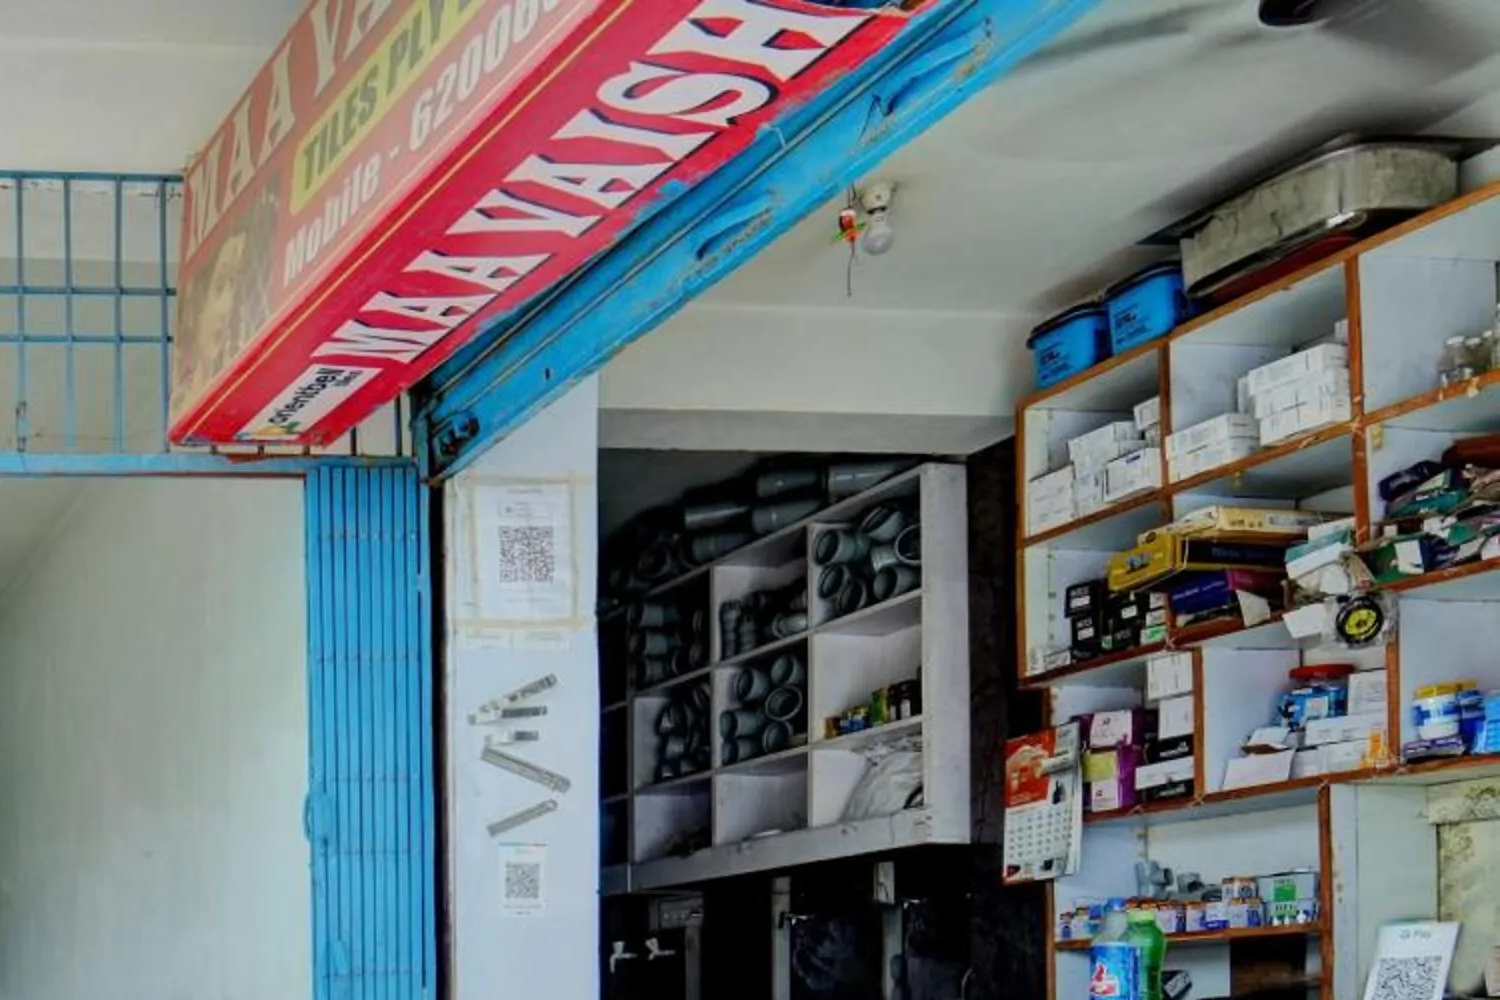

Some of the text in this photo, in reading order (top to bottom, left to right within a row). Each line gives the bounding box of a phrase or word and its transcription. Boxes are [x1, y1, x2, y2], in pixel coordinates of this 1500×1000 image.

[185, 40, 296, 263] MAA
[283, 152, 380, 288] Mobile
[409, 0, 562, 152] 6200
[303, 0, 474, 191] TILES PLY
[312, 250, 555, 364] MAA
